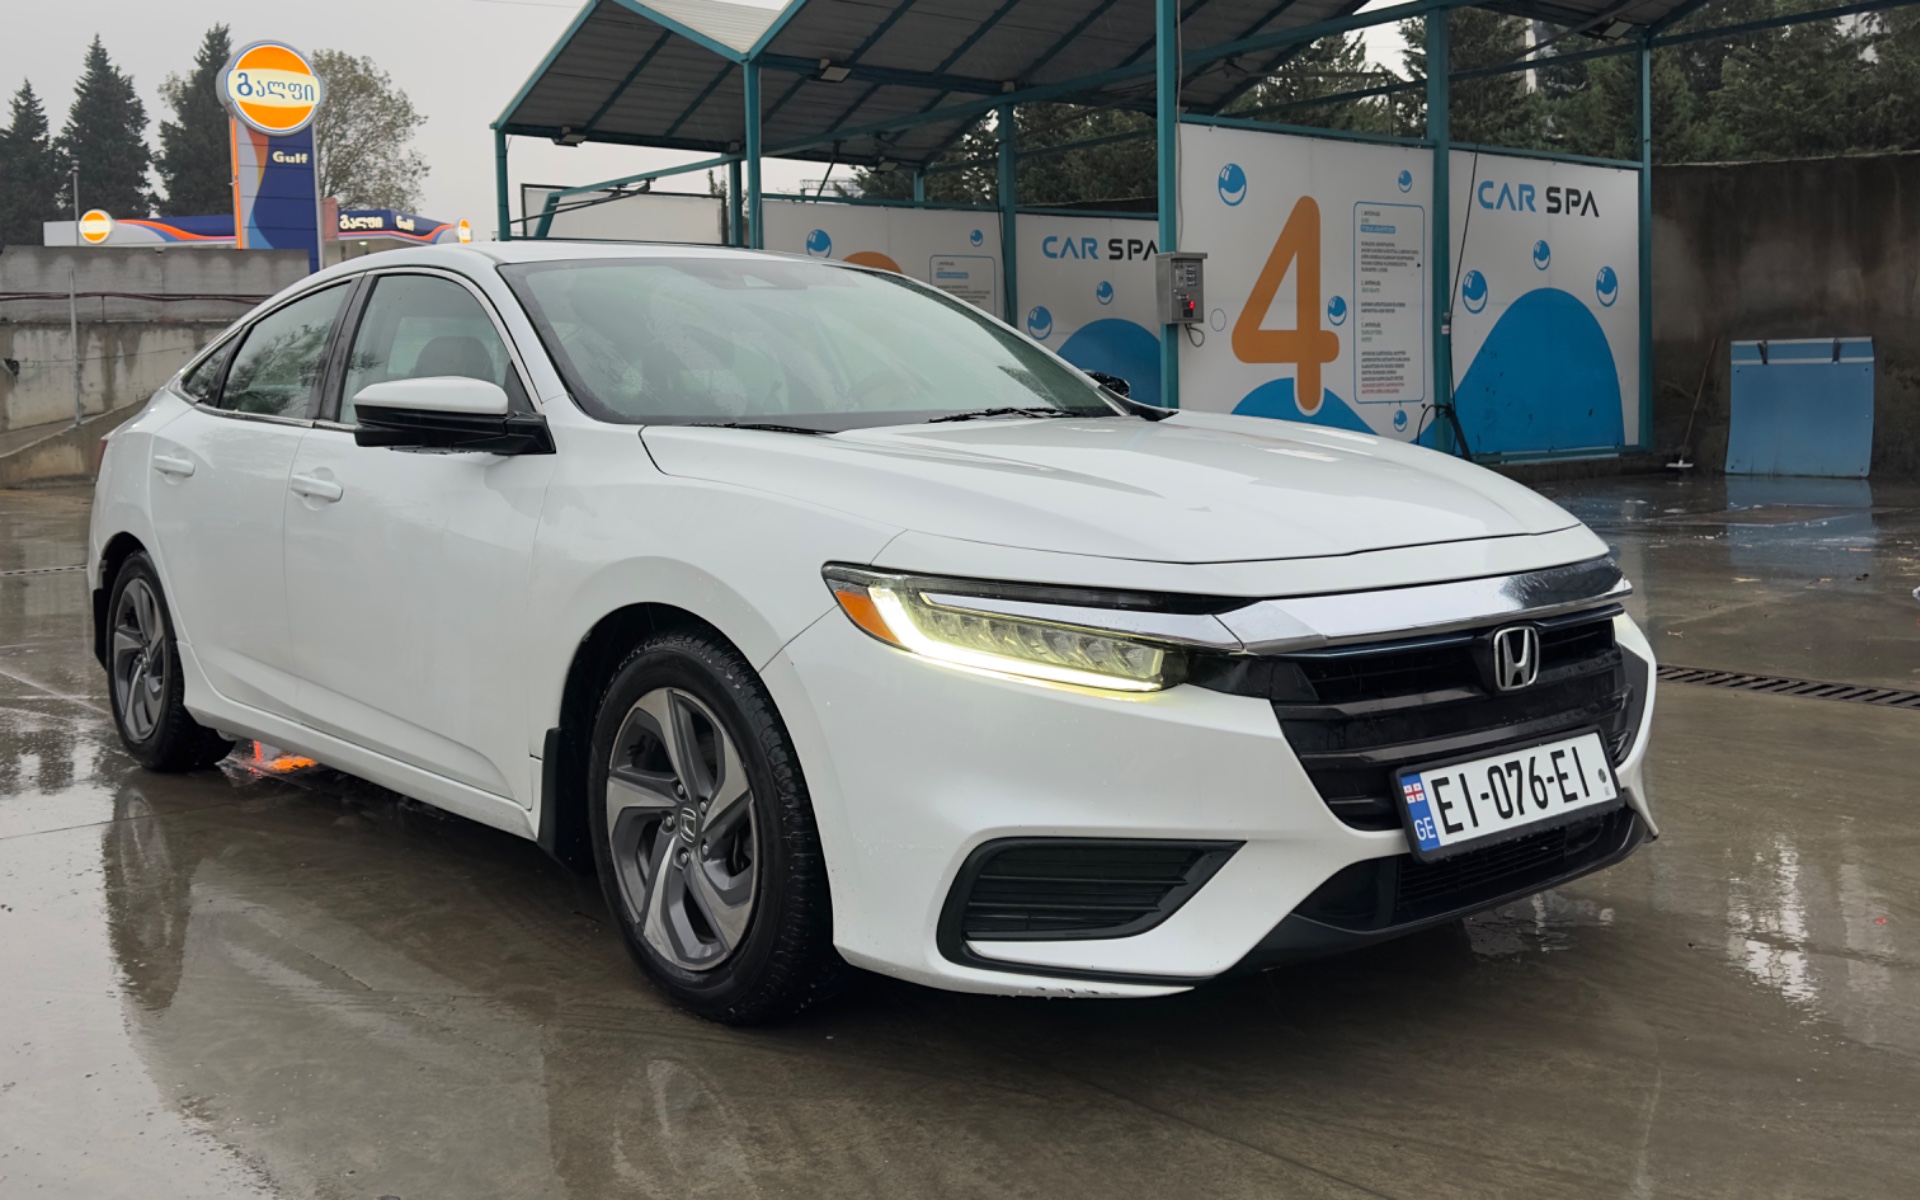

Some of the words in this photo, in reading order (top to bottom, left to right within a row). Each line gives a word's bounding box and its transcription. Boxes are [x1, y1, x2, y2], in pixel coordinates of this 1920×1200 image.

[237, 72, 315, 102] გალფი
[272, 151, 309, 164] Gulf
[1477, 180, 1537, 212] CAR
[1545, 186, 1600, 218] SPA
[339, 214, 383, 230] გალფი
[1042, 235, 1099, 260] CAR
[1108, 238, 1159, 261] SPA
[1231, 195, 1340, 411] 4
[1430, 746, 1591, 835] EI-076-EI
[1414, 816, 1436, 841] GE
